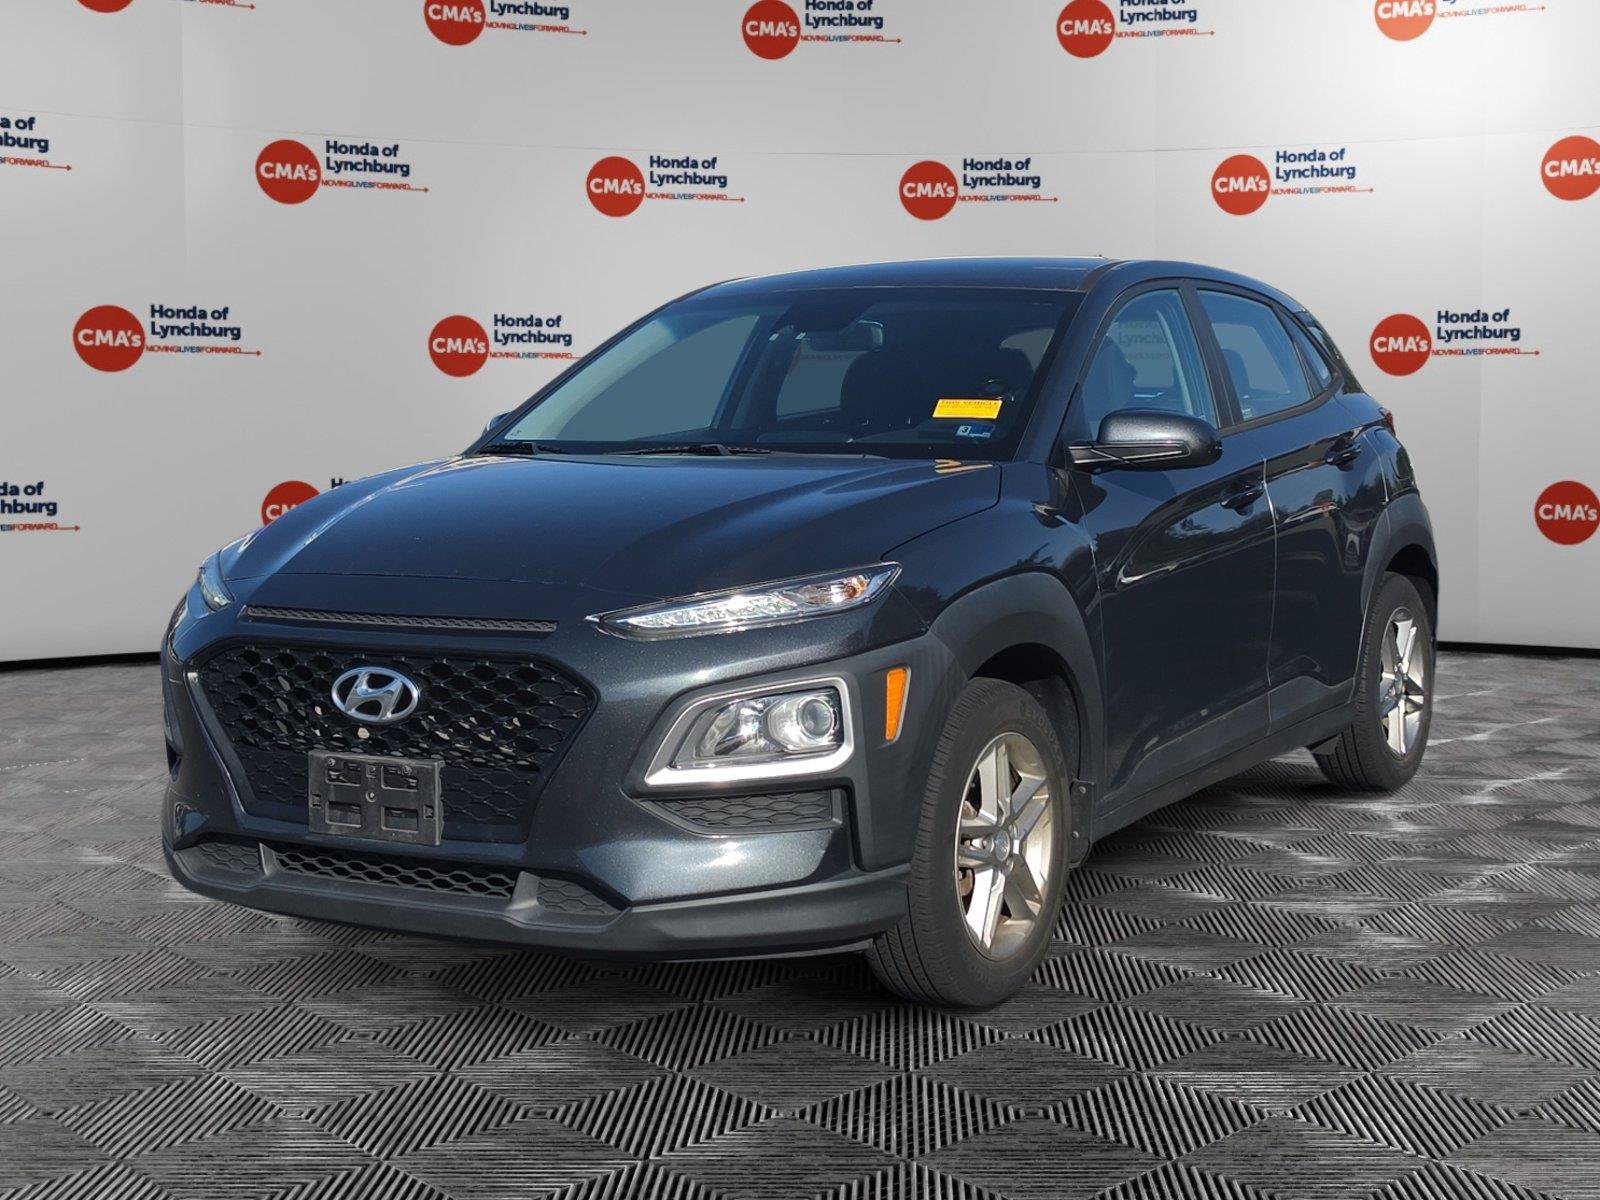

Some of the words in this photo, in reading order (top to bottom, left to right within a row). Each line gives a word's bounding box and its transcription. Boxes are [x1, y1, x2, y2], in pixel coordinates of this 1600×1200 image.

[429, 3, 482, 23] CMA's
[490, 0, 569, 20] Lynchburg
[1120, 9, 1197, 25] Lynchburg
[1378, 2, 1434, 20] CMA's
[745, 20, 798, 37] CMA's
[805, 13, 883, 29] Lynchburg
[1061, 19, 1112, 36] CMA's
[15, 116, 35, 131] of
[326, 140, 379, 156] Honda
[382, 144, 399, 158] of
[1275, 149, 1326, 163] Honda
[1329, 148, 1345, 161] of
[326, 156, 410, 178] Lynchburg
[650, 155, 699, 168] Honda
[701, 156, 717, 169] of
[963, 158, 1011, 170] Honda
[1014, 158, 1031, 170] of
[1544, 158, 1600, 178] CMA's
[260, 161, 317, 181] CMA's
[650, 171, 727, 188] Lynchburg
[1275, 165, 1356, 182] Lynchburg
[590, 178, 641, 194] CMA's
[963, 173, 1041, 189] Lynchburg
[1215, 176, 1268, 193] CMA's
[903, 182, 954, 198] CMA's
[150, 304, 207, 319] Honda
[210, 306, 229, 320] of
[1437, 309, 1489, 323] Honda
[1492, 308, 1510, 322] of
[494, 314, 542, 327] Honda
[546, 314, 562, 328] of
[77, 328, 141, 347] CMA's
[150, 321, 241, 340] Lynchburg
[494, 330, 572, 347] Lynchburg
[1437, 326, 1520, 343] Lynchburg
[432, 337, 486, 353] CMA's
[1373, 336, 1428, 352] CMA's
[23, 481, 44, 496] of
[1539, 503, 1598, 521] CMA's
